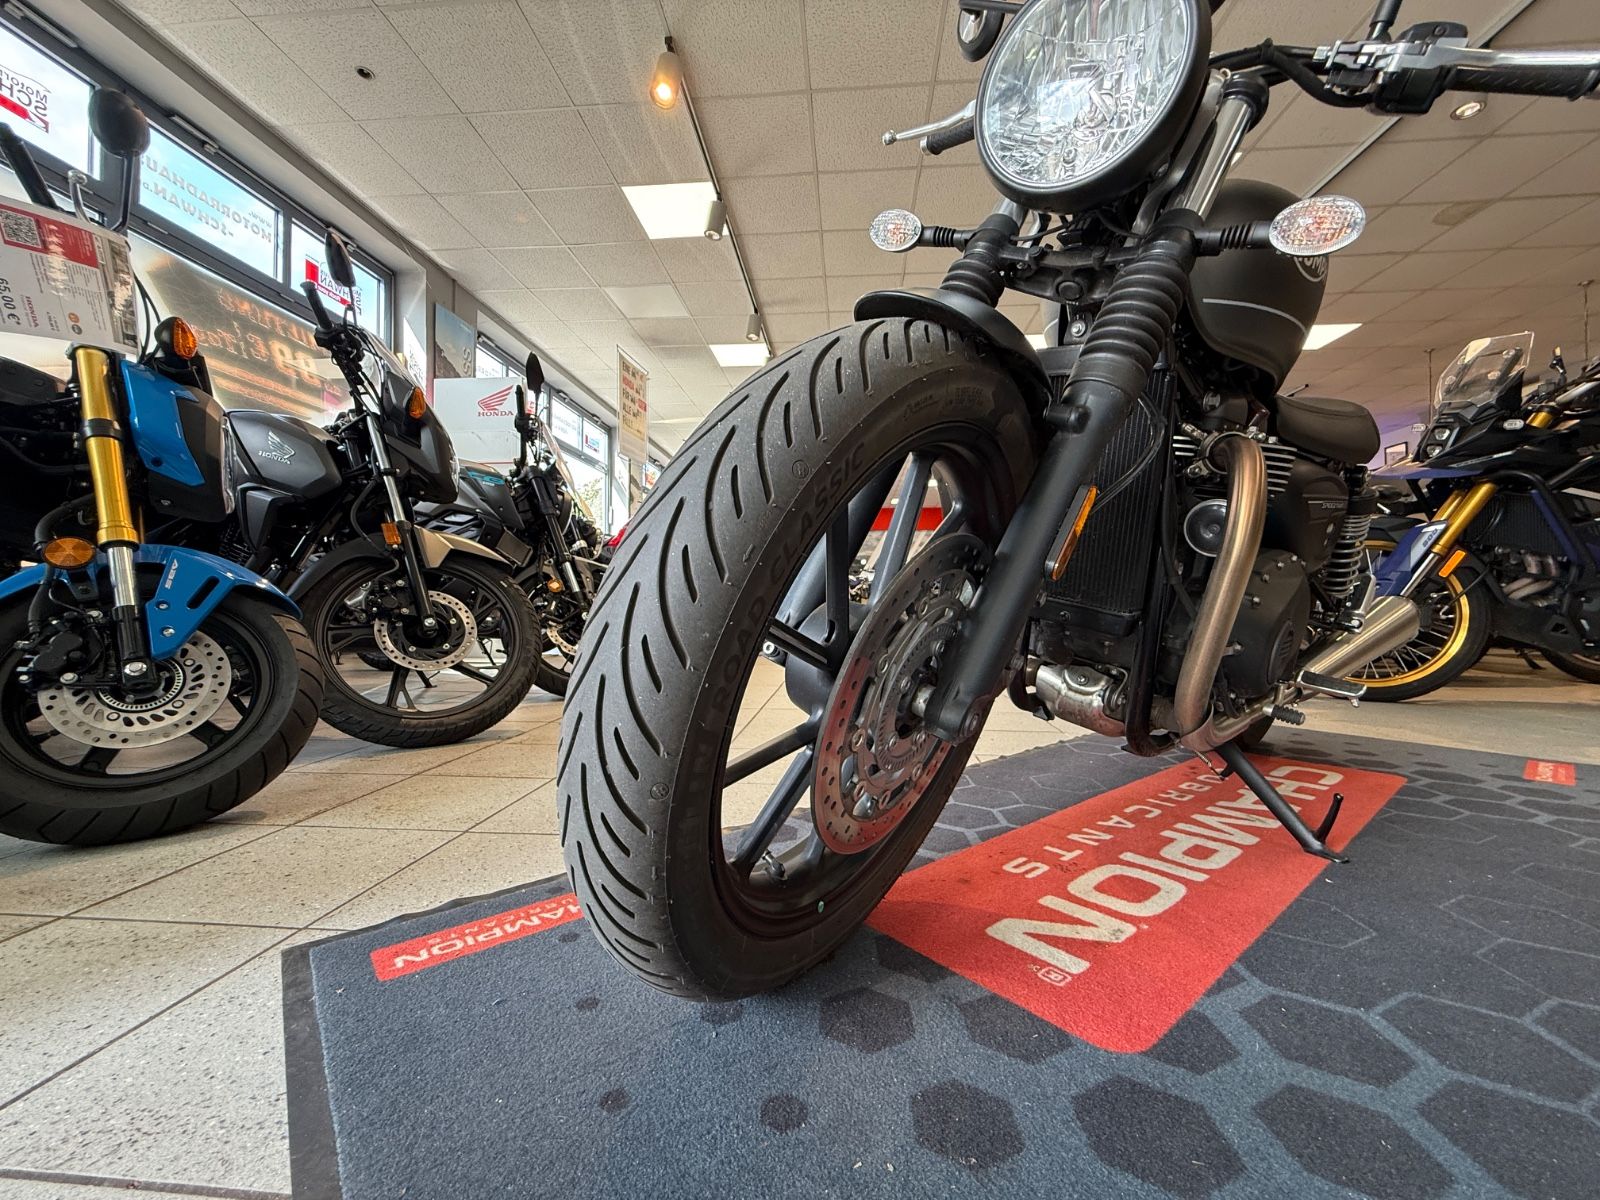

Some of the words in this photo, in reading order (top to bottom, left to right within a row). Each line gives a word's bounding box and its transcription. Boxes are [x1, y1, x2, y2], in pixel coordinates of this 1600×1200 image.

[258, 450, 291, 465] HONDA
[767, 441, 866, 587] CLASSIC
[985, 765, 1344, 974] CHAMPION
[1002, 767, 1226, 879] UBRICANTS
[393, 904, 582, 969] HAMPION
